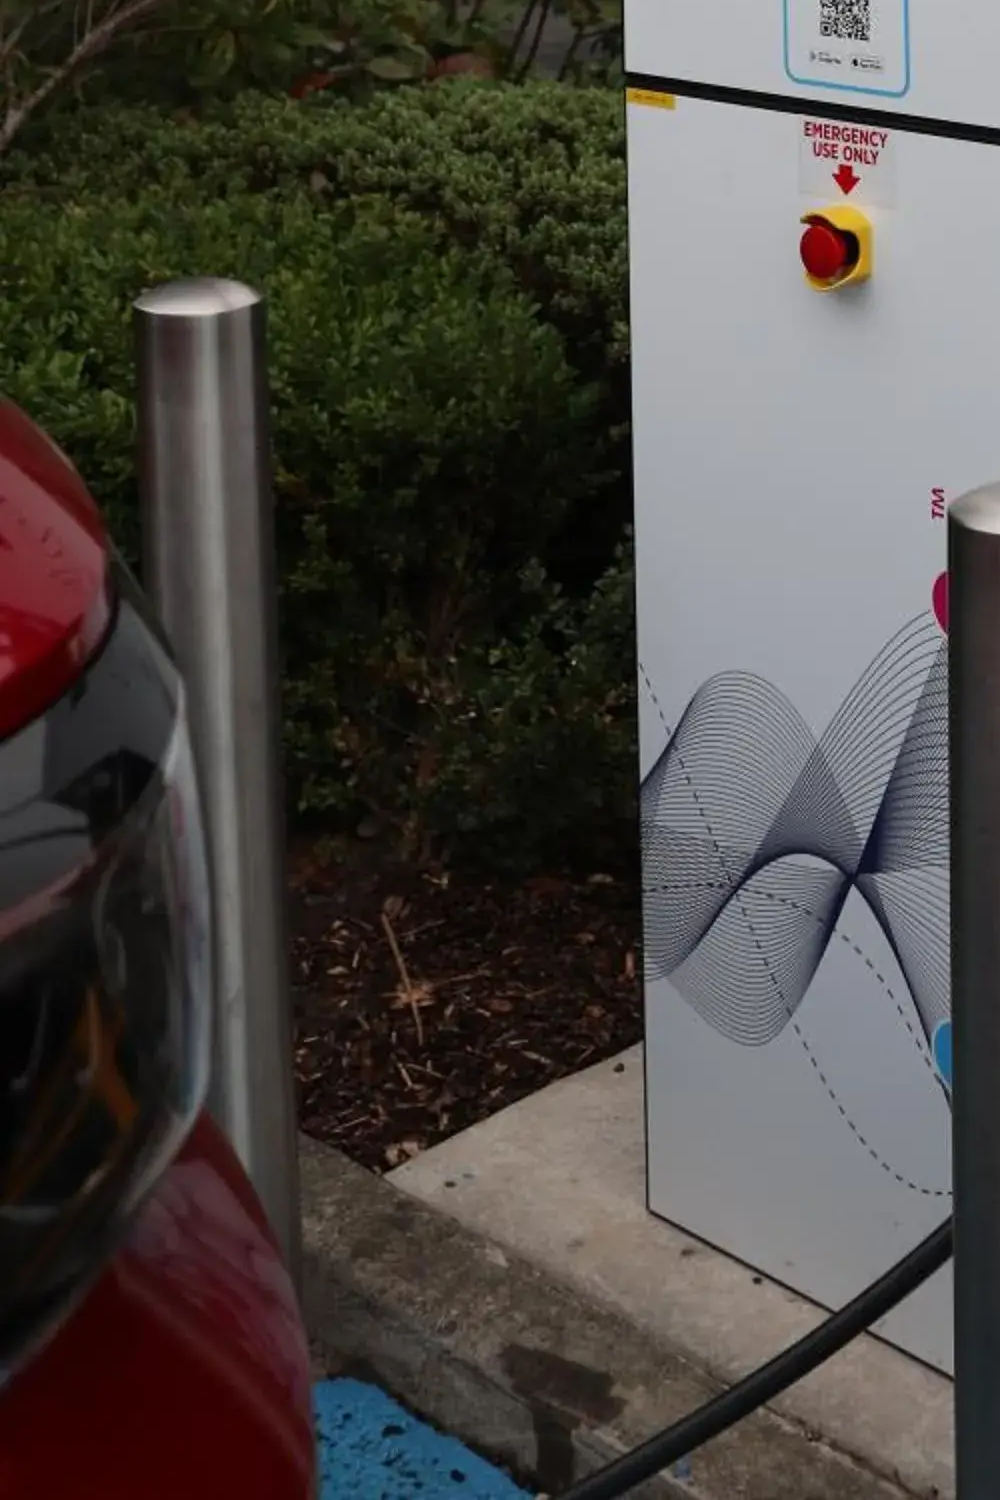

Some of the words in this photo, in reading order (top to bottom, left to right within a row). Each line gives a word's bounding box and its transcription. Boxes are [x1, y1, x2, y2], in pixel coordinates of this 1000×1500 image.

[803, 121, 889, 149] EMERGENCY
[813, 141, 839, 160] USE
[843, 146, 880, 166] ONLY
